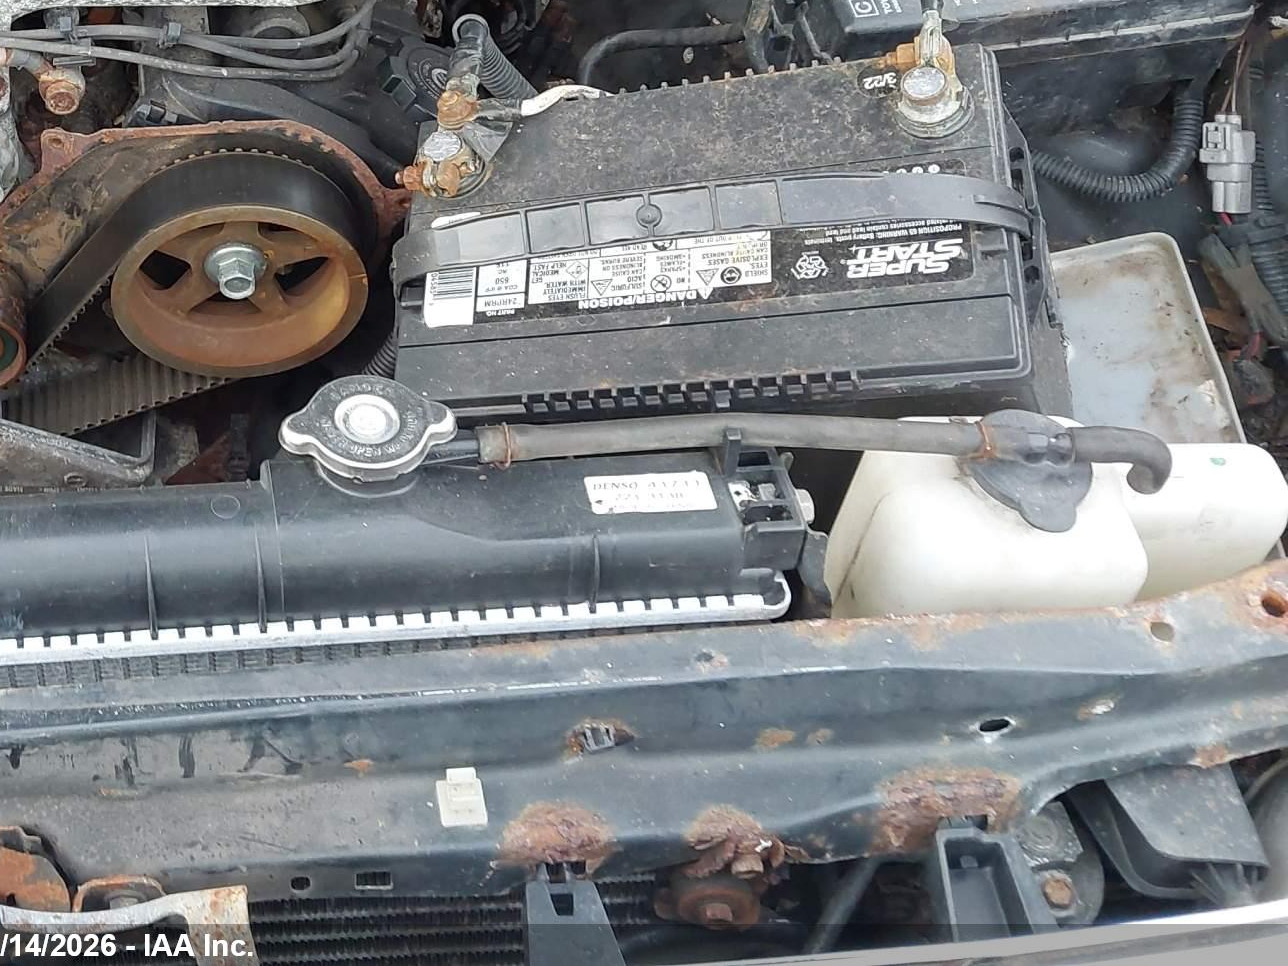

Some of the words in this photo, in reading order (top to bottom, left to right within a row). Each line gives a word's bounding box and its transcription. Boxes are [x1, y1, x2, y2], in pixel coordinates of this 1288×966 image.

[854, 0, 873, 14] C
[875, 228, 908, 239] WARNING:
[917, 223, 962, 236] PROPOSITION
[846, 238, 963, 264] START
[708, 258, 730, 266] GASES
[731, 254, 768, 264] EXPLOSIVE
[744, 269, 768, 277] SHIELD
[846, 258, 950, 279] SUPER
[543, 286, 585, 295] IMMEDIATELY
[611, 283, 643, 292] SULFURIC
[578, 290, 697, 310] DANGER/POISON
[497, 308, 516, 316] PART
